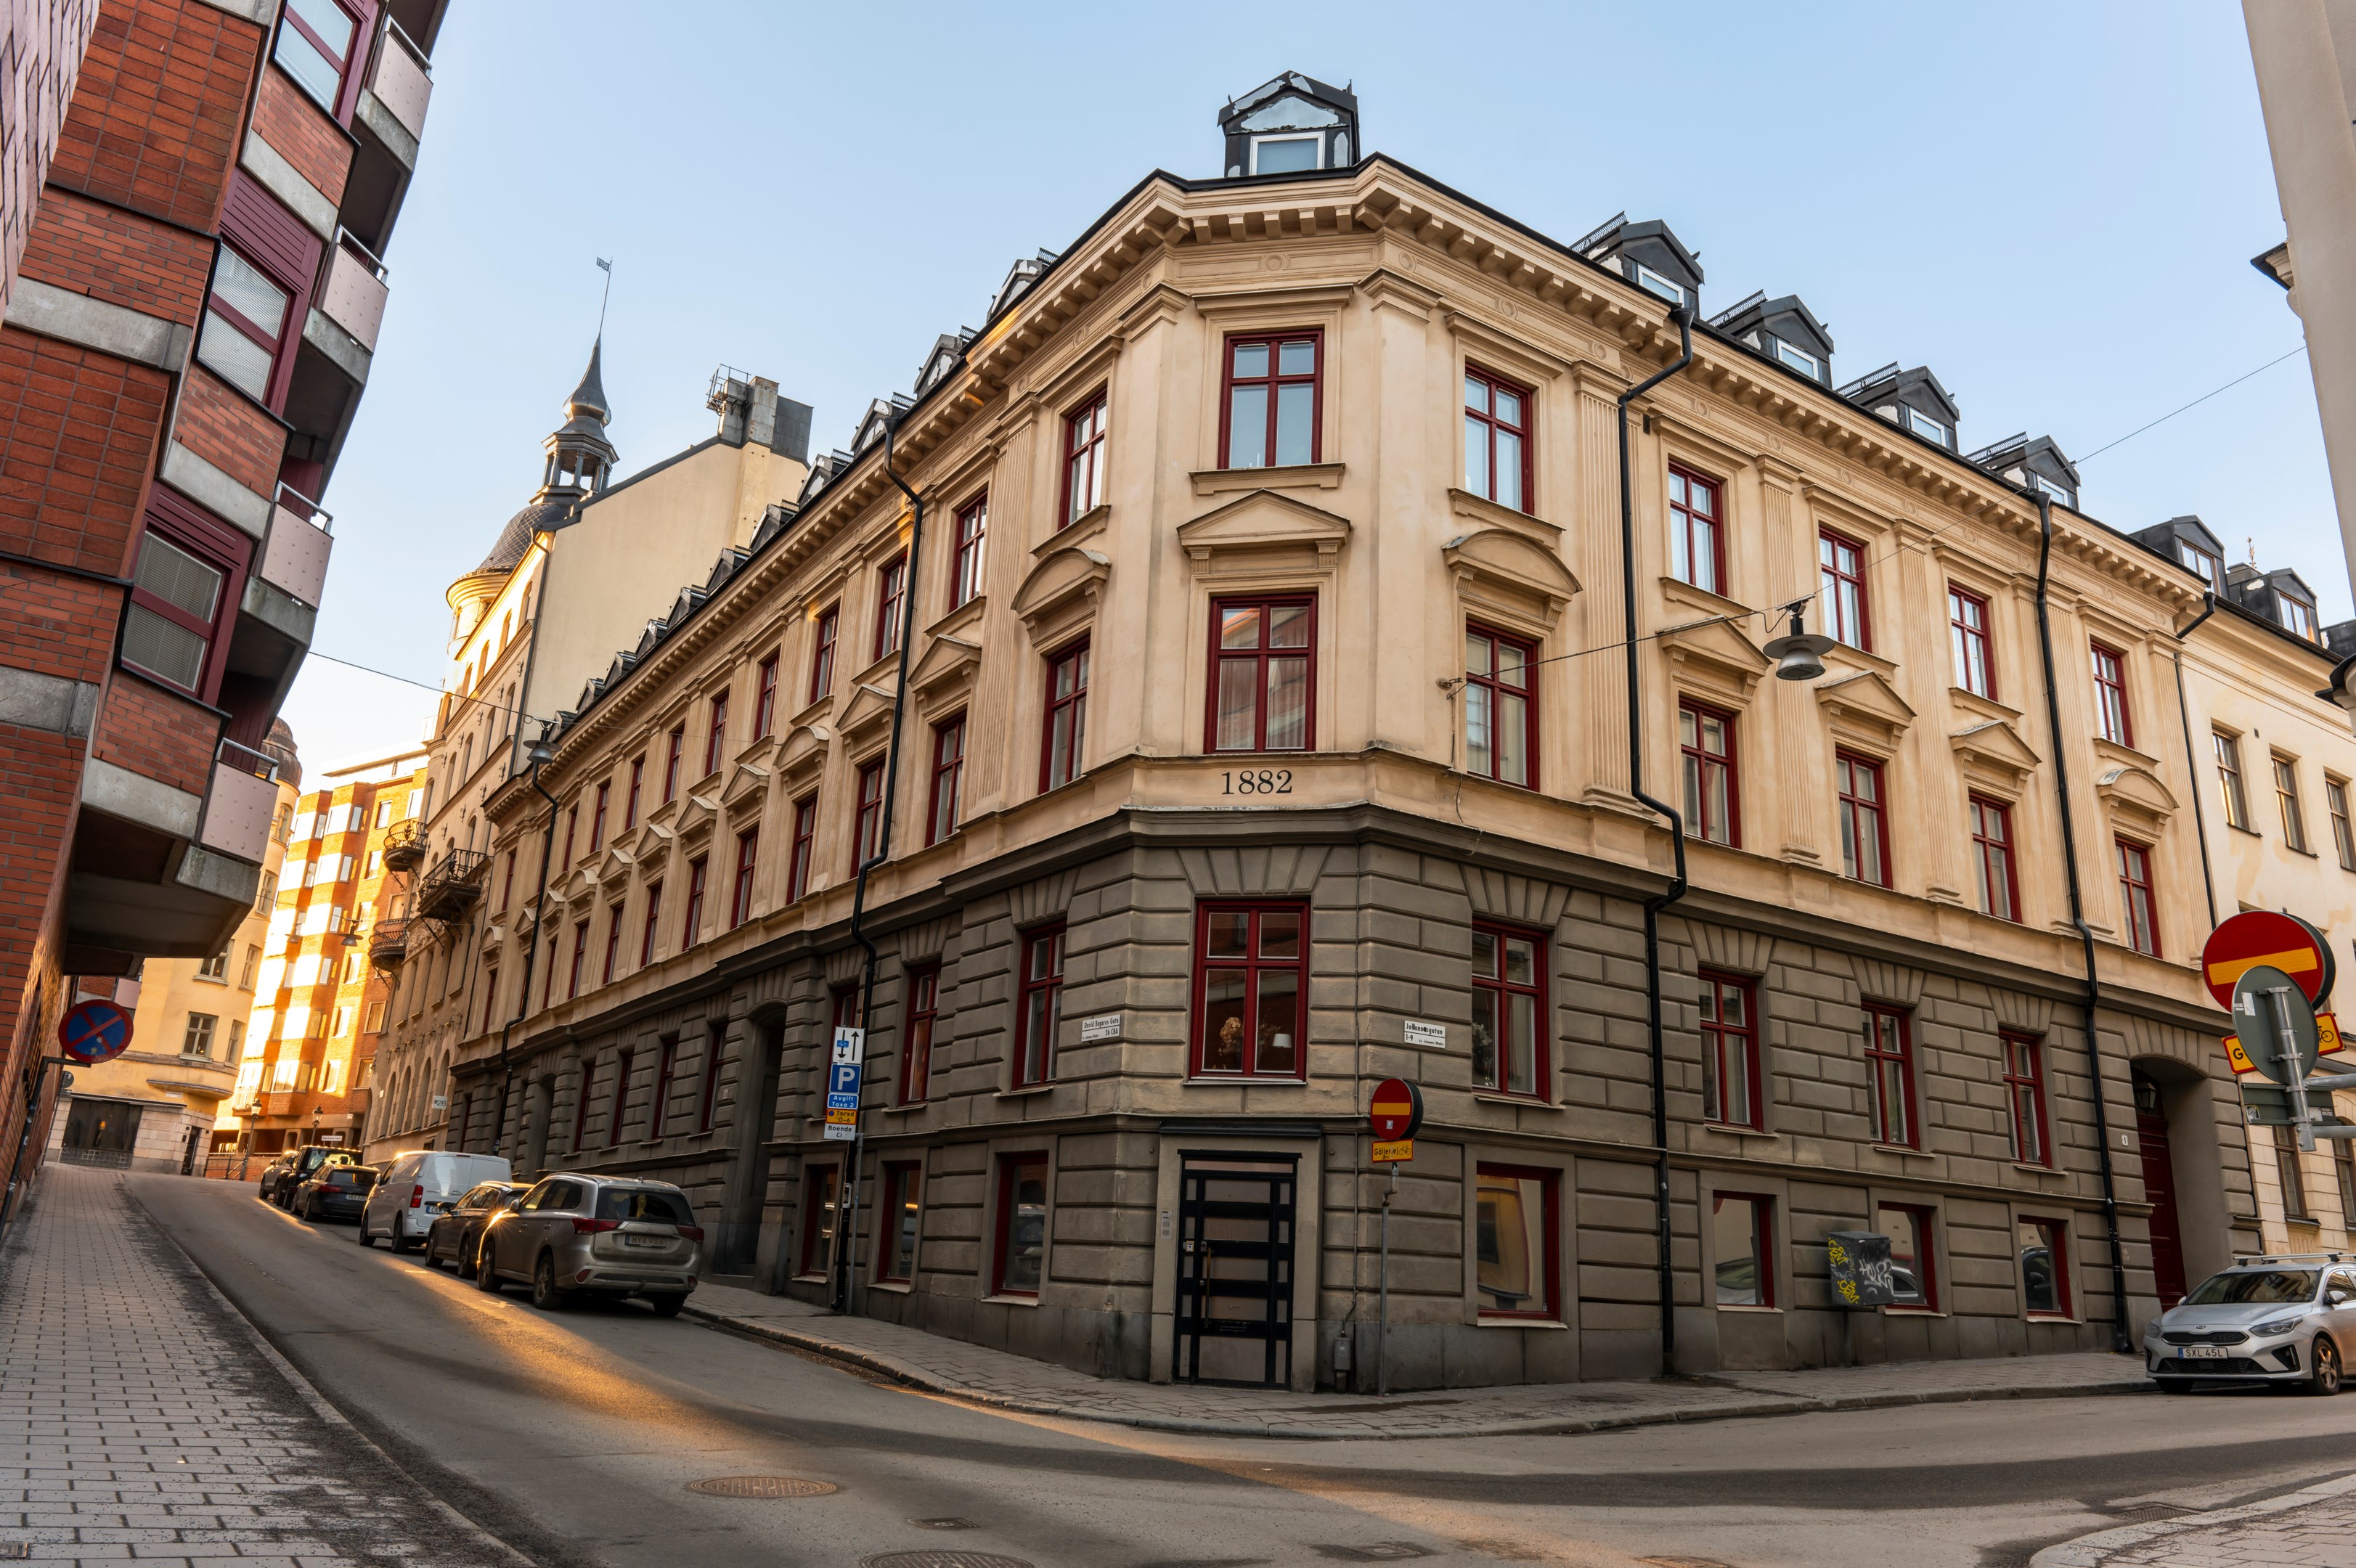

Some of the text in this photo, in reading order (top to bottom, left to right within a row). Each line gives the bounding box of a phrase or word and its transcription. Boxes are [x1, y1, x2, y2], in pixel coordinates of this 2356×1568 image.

[1221, 769, 1292, 795] 1882
[838, 1067, 855, 1090] P
[1393, 1147, 1398, 1156] ej
[2185, 1349, 2223, 1357] SXL 45L
